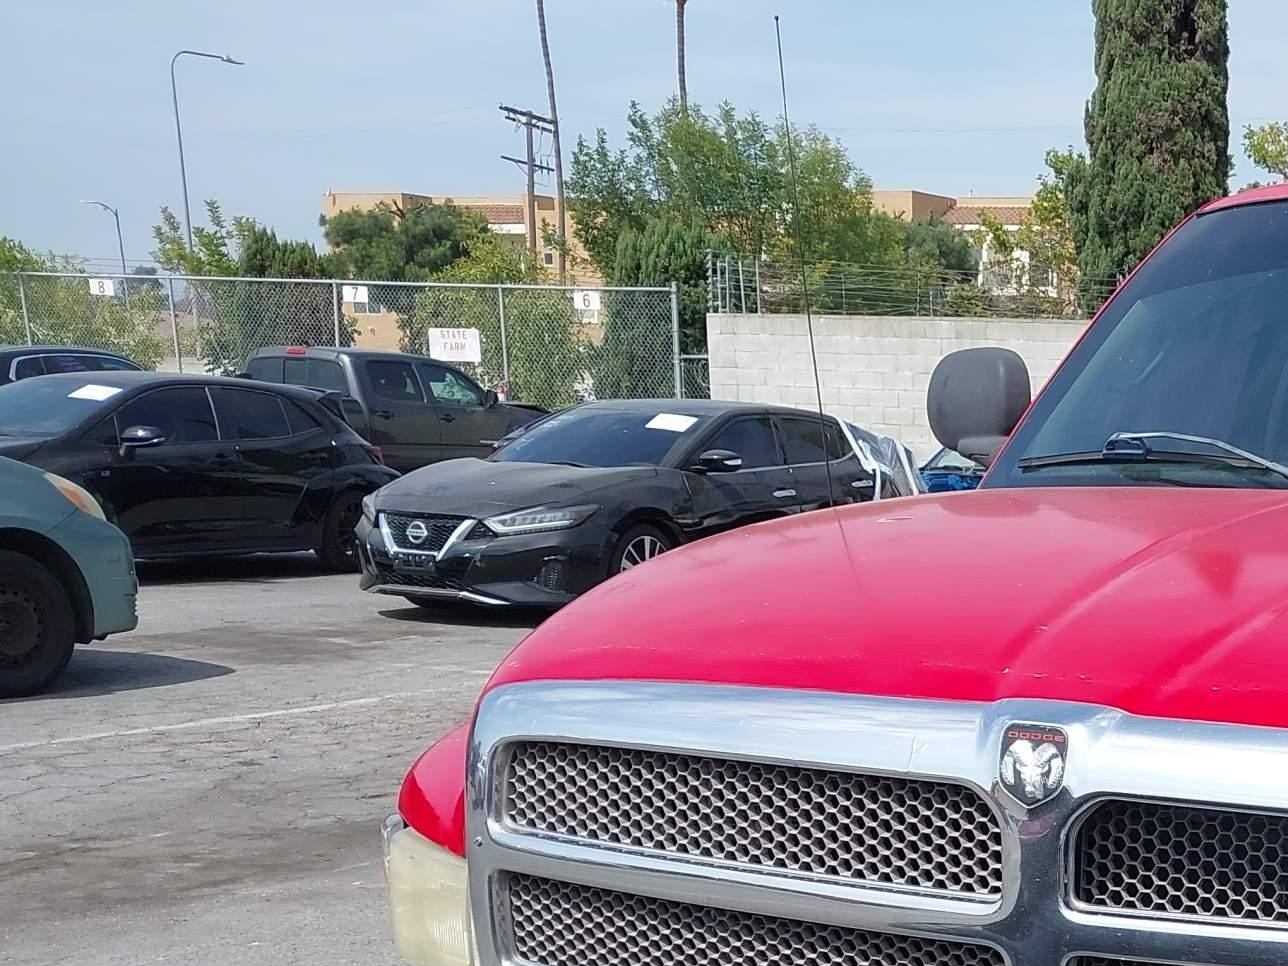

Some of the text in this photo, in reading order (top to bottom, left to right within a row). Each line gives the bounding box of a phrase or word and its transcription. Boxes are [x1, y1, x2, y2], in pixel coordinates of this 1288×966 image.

[98, 280, 105, 294] 8
[351, 286, 359, 301] 7
[583, 293, 591, 308] 6
[440, 329, 468, 340] STATE
[443, 341, 466, 352] FARM
[1008, 731, 1065, 743] DODGE
